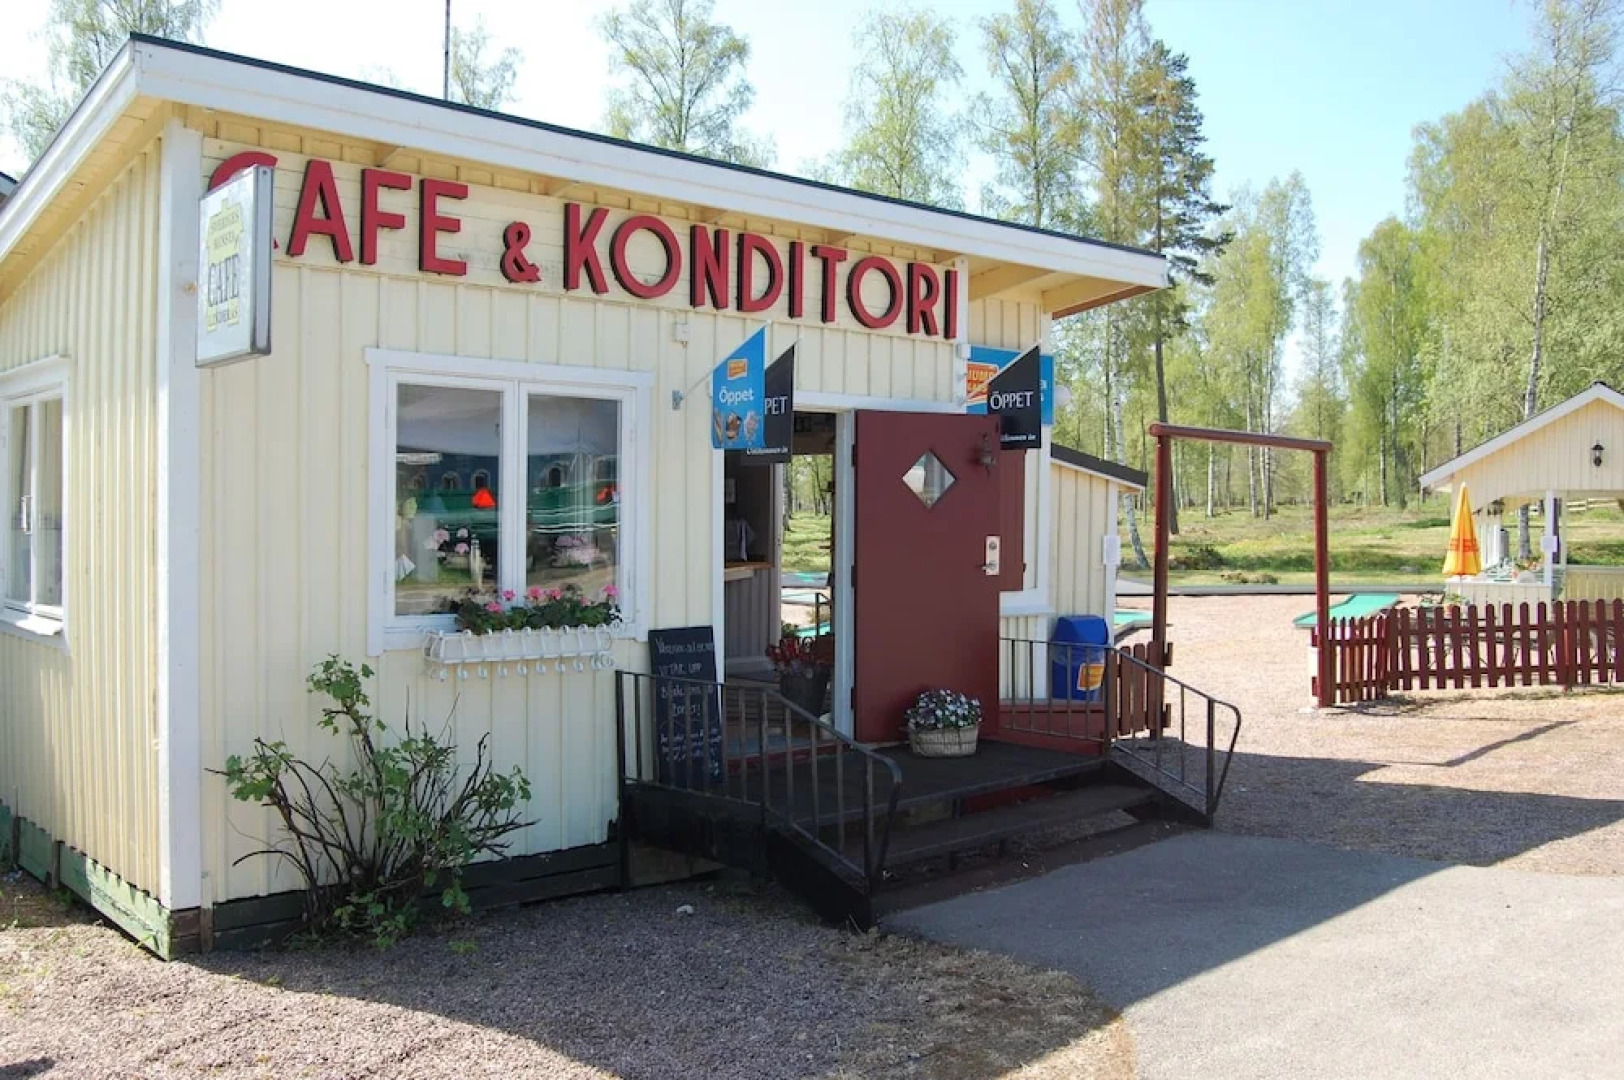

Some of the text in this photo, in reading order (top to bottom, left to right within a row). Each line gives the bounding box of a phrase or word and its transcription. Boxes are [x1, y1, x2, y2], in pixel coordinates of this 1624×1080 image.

[501, 221, 541, 283] &
[564, 202, 958, 339] KONDITORI
[719, 386, 755, 405] Öppet
[990, 391, 1034, 409] ÖPPET
[764, 396, 788, 414] PET
